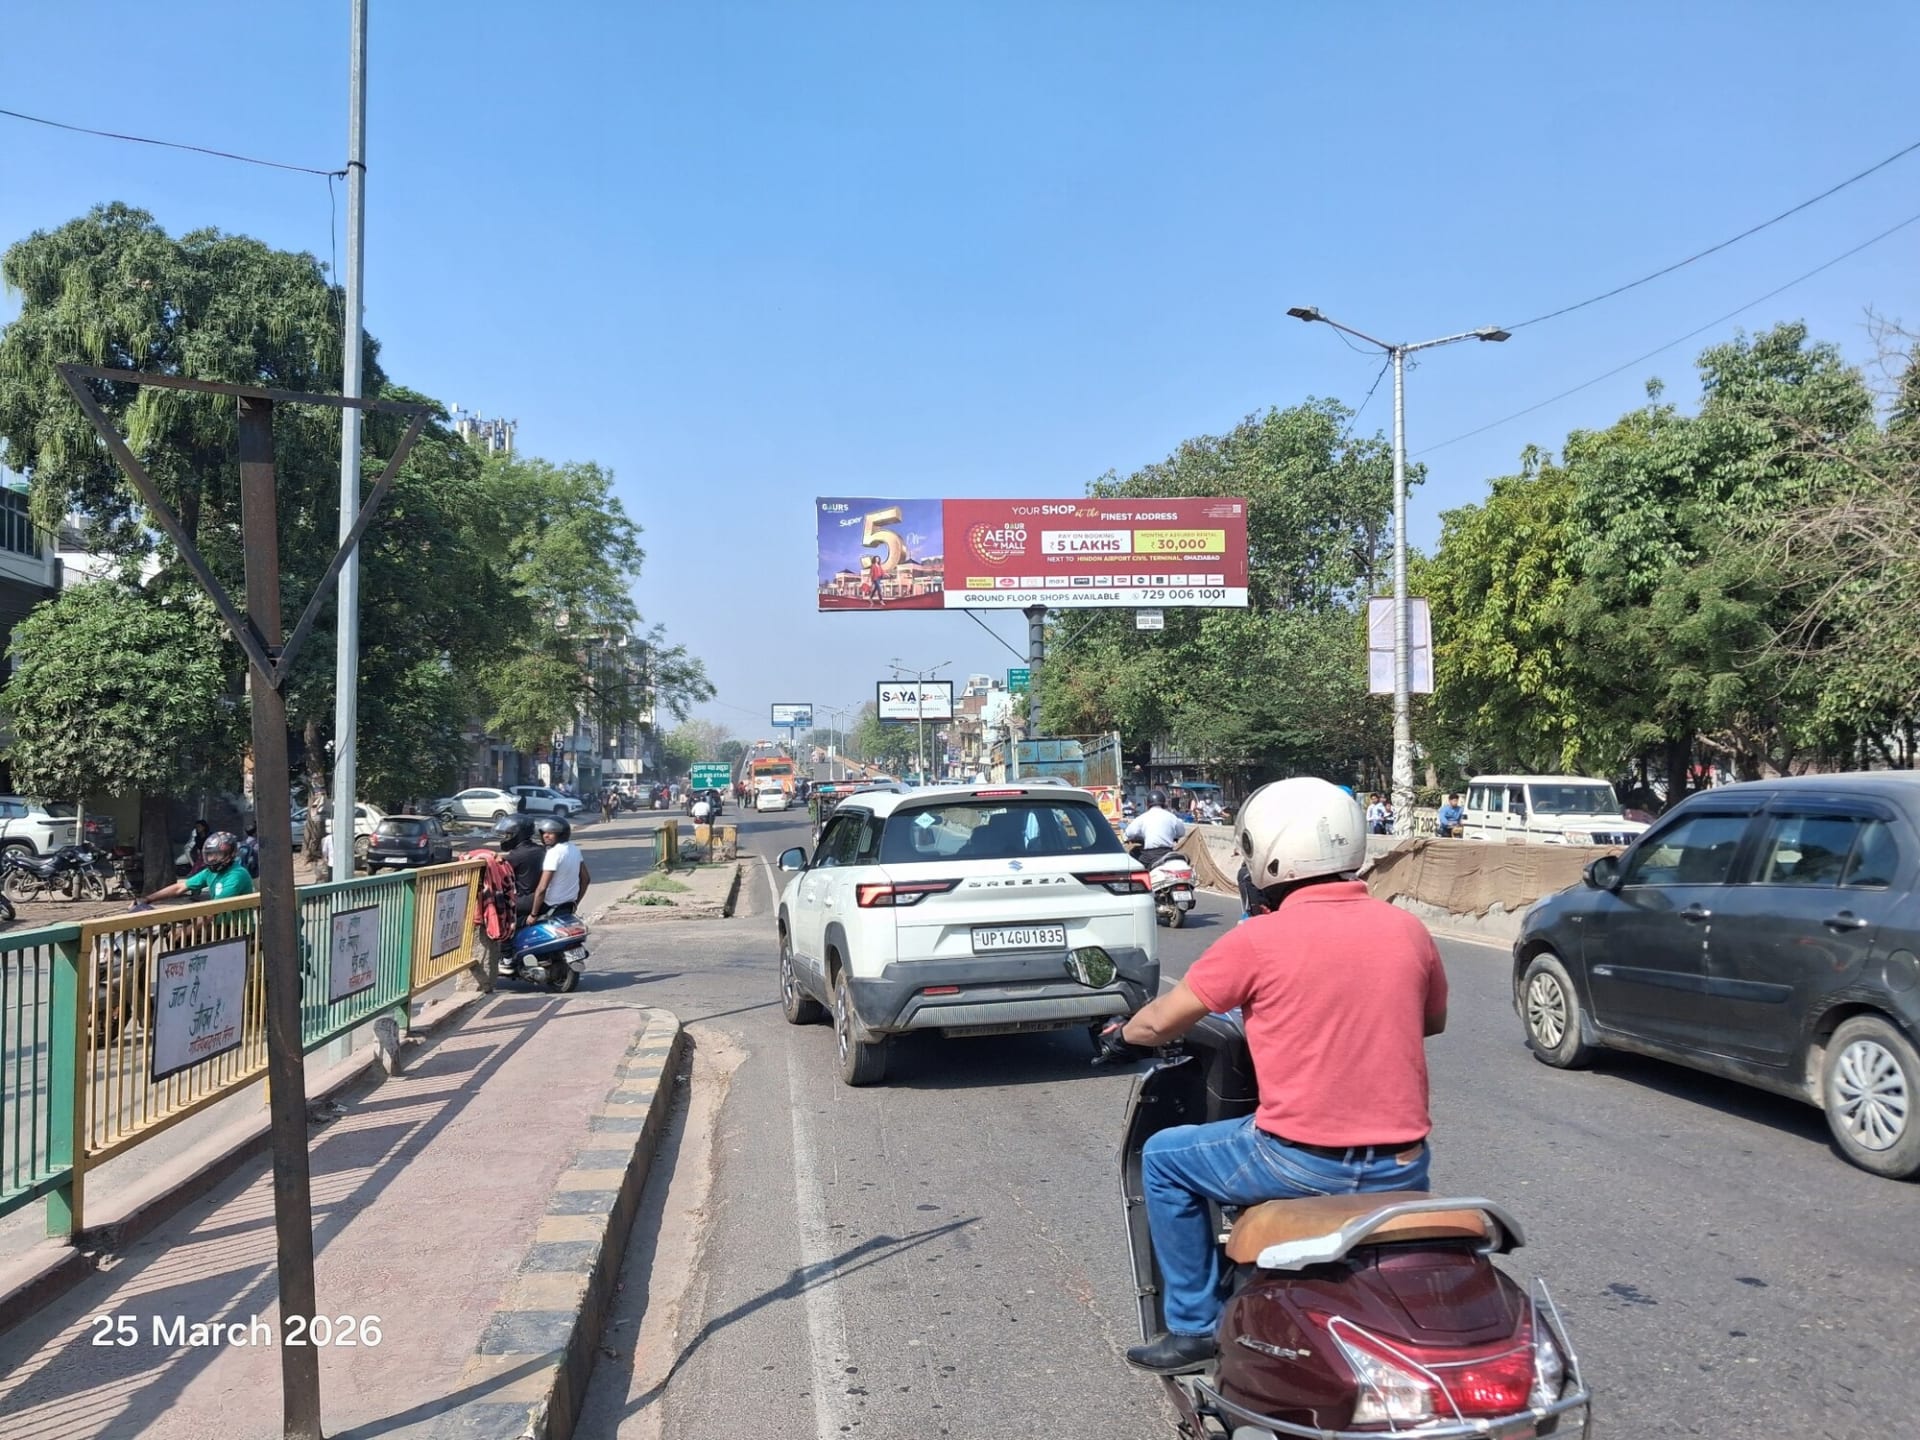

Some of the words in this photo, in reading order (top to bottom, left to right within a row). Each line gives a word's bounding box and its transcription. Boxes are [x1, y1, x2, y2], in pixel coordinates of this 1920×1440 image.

[822, 503, 849, 511] GAURS
[1012, 506, 1040, 515] YOUR
[1042, 505, 1076, 515] SHOP
[1101, 513, 1133, 521] FINEST
[1135, 512, 1178, 520] ADDRESS
[861, 506, 907, 572] 5
[984, 530, 1027, 542] AERO
[1000, 541, 1026, 550] MALL
[964, 594, 1004, 602] GROUND
[1040, 593, 1070, 601] SHOPS
[1142, 590, 1165, 599] 729
[1169, 589, 1194, 599] 006
[1199, 589, 1226, 598] 1001
[882, 691, 917, 703] SAYA
[981, 929, 1063, 947] UP14GU1835
